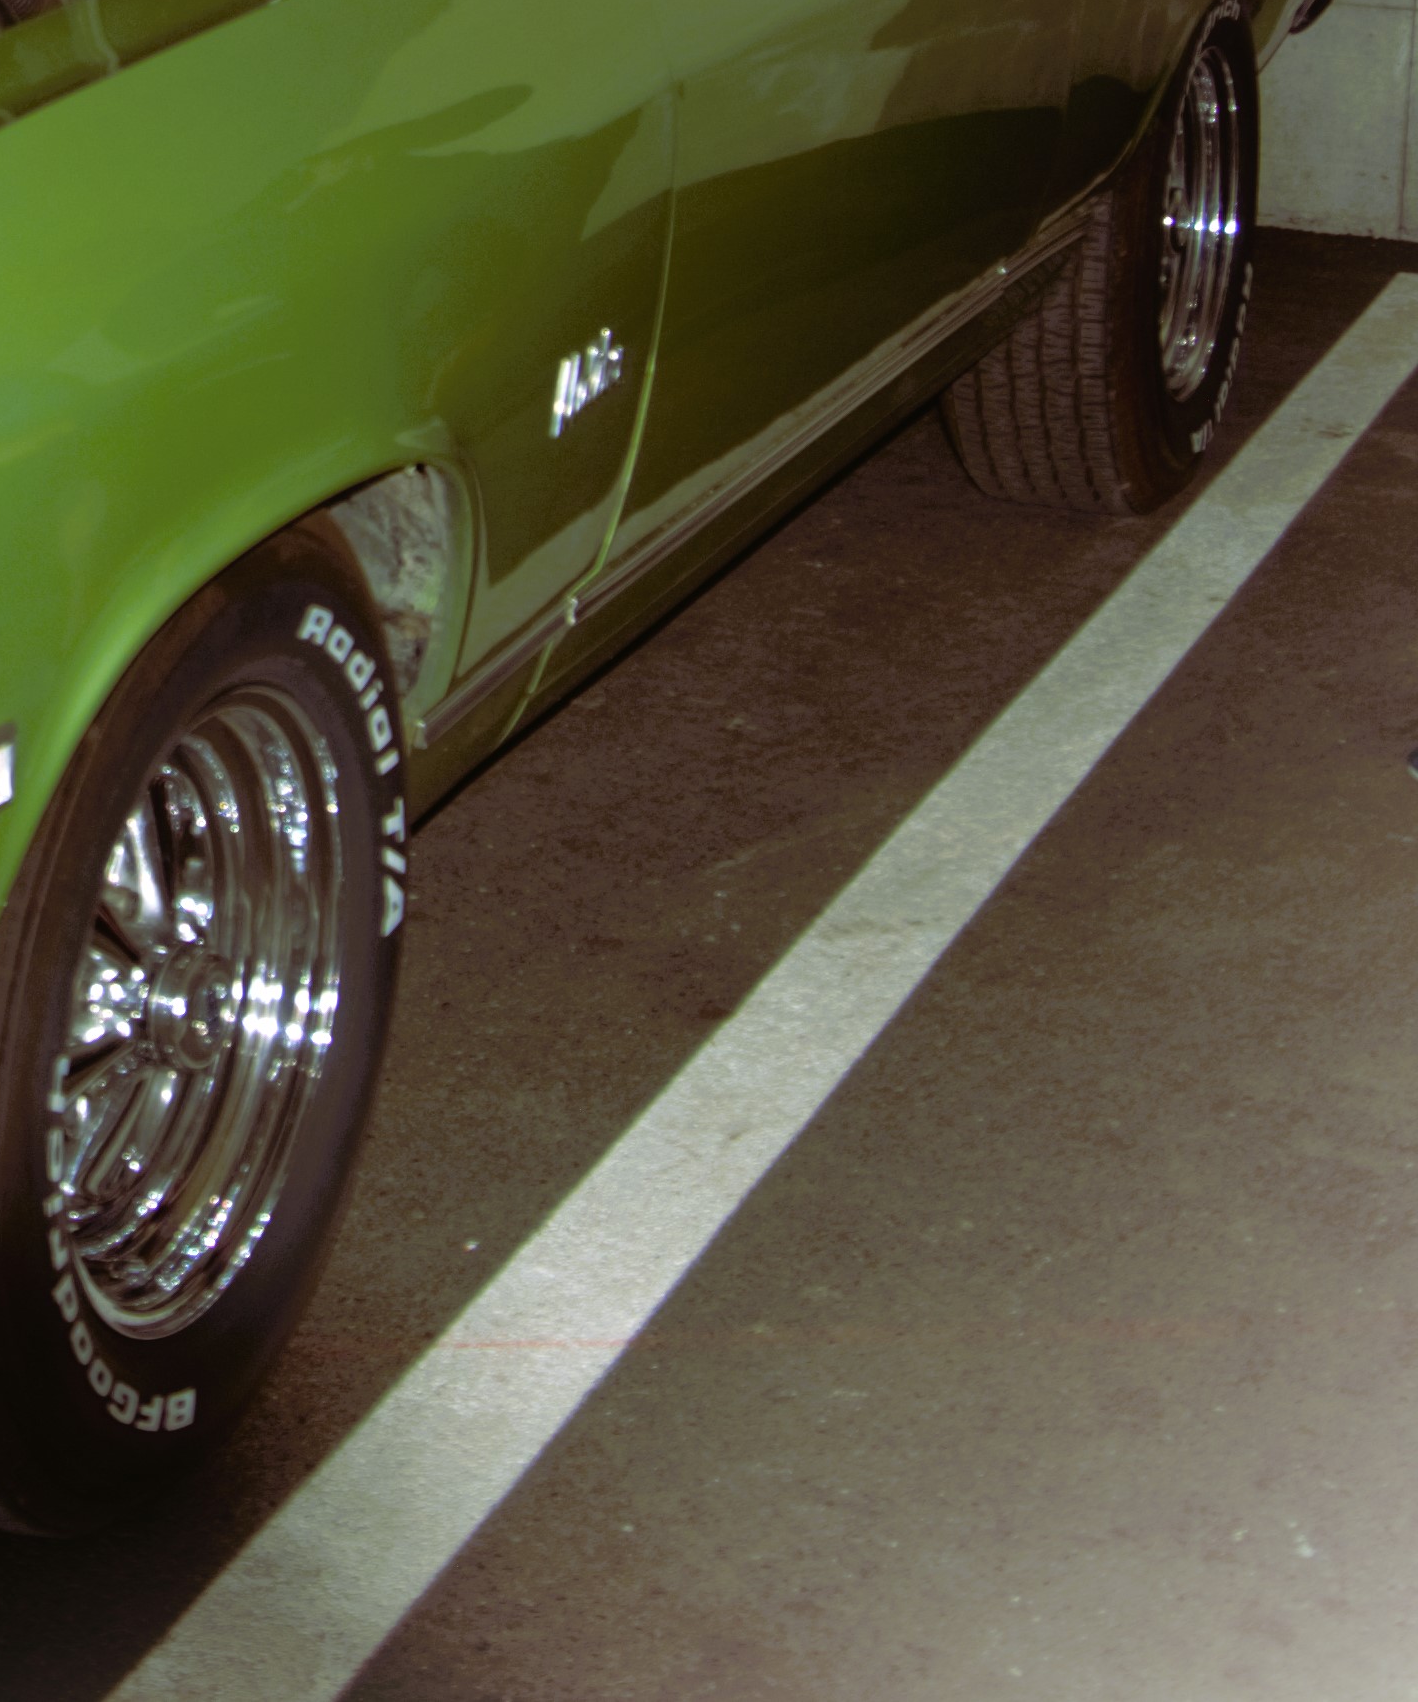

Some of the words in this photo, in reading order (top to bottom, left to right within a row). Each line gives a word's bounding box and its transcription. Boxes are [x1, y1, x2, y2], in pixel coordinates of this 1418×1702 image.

[296, 602, 401, 776] Radial
[380, 795, 407, 938] T/A
[43, 1055, 197, 1433] BFGoodrich
